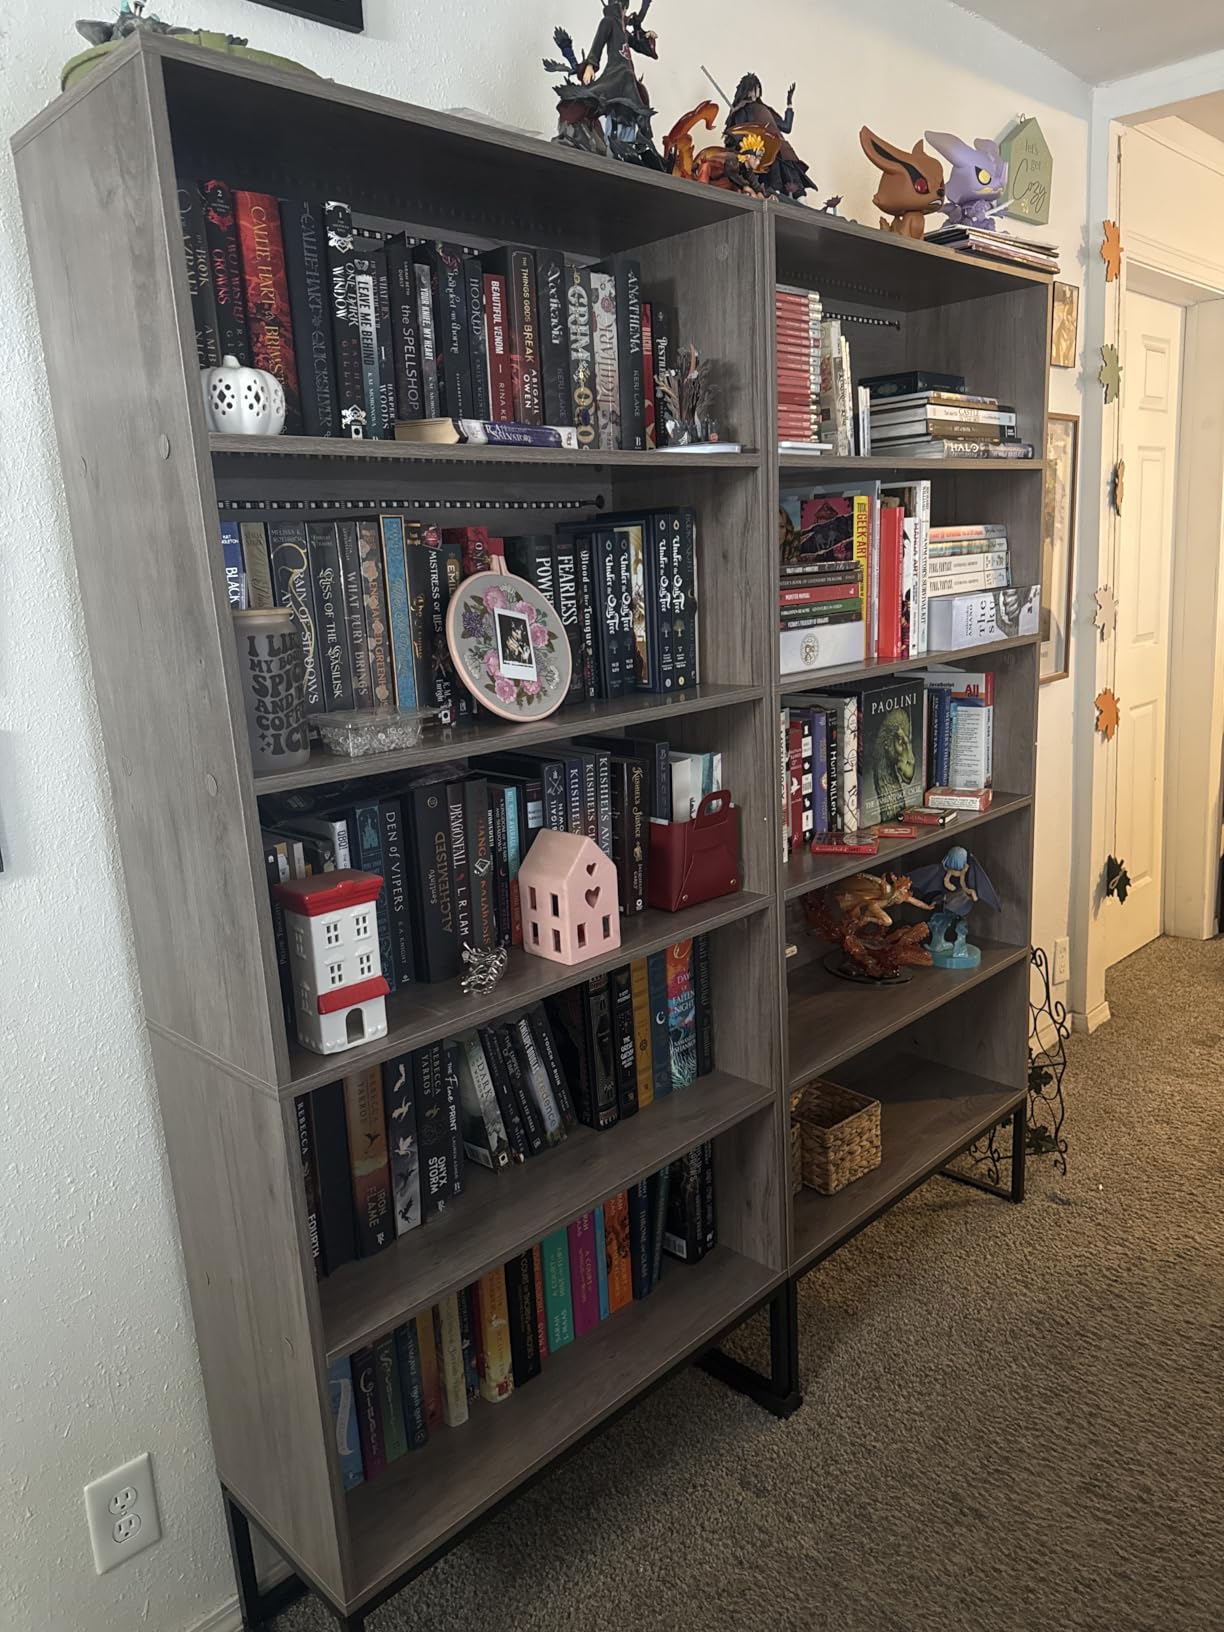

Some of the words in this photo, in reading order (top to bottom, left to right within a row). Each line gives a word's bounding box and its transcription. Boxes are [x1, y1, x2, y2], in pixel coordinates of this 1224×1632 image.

[1012, 158, 1047, 214] Cozy
[251, 206, 271, 261] CALLIE
[212, 249, 229, 304] CROWNS
[257, 267, 276, 304] HART
[345, 263, 356, 289] ONE
[521, 269, 531, 299] THINGS
[332, 266, 348, 320] WINDOW
[346, 292, 360, 327] DARK
[357, 280, 370, 309] LEAVE
[420, 288, 430, 305] YOUR
[470, 278, 481, 336] HOOKED
[491, 280, 502, 324] BEAUTIFUL
[359, 312, 373, 328] ME
[401, 305, 411, 325] the
[421, 305, 432, 327] KNIFE,
[523, 300, 532, 323] GODS
[568, 285, 591, 361] GRIM
[628, 270, 641, 354] ANATHEMA
[361, 330, 375, 366] BEHIND
[423, 328, 433, 340] MY
[424, 340, 434, 360] HEART
[493, 325, 504, 355] VENOM
[523, 324, 535, 363] BREAK
[264, 326, 284, 384] BRIMST
[403, 328, 419, 410] SPELLSHOP
[380, 384, 390, 430] WOODS
[499, 382, 507, 408] RINA
[523, 374, 532, 409] OWEN
[531, 369, 540, 415] ABIGAIL
[950, 441, 980, 453] HALO
[672, 535, 683, 568] Under
[856, 513, 867, 559] GEEK-ART
[580, 549, 591, 583] Blood
[605, 553, 616, 587] Under
[619, 552, 631, 585] Under
[658, 539, 669, 570] Under
[225, 567, 241, 604] BLACK
[347, 571, 360, 609] WHAT
[428, 549, 441, 600] MISTRESS
[447, 564, 458, 599] EMIL
[557, 555, 578, 626] FEARLESS
[323, 603, 336, 618] OF
[433, 601, 441, 611] OF
[658, 592, 672, 613] Tree
[672, 592, 686, 614] Tree
[977, 600, 987, 636] The
[326, 622, 338, 644] THE
[349, 614, 364, 645] FURY
[432, 613, 443, 633] LIES
[583, 606, 594, 647] Tongue
[606, 612, 620, 635] Tree
[620, 609, 633, 632] Tree
[246, 635, 260, 658] I
[265, 632, 302, 658] LIK
[249, 659, 274, 673] MY
[327, 644, 344, 699] BASILISK
[354, 650, 369, 697] BRINGS
[254, 692, 294, 715] AND
[871, 693, 917, 715] PAOLINI
[965, 684, 980, 697] All
[585, 763, 596, 822] KUSHIEL'S
[599, 756, 611, 822] KUSHIEL'S
[385, 811, 398, 842] DEN
[449, 803, 467, 869] DRAGONFALL
[388, 846, 400, 859] of
[391, 861, 404, 912] VIPERS
[435, 831, 453, 933] ALCHEMISED
[457, 886, 467, 897] L.
[458, 899, 468, 911] R.
[459, 912, 470, 936] LAM
[677, 972, 692, 985] DAY
[673, 1001, 696, 1014] NIGHT
[421, 1054, 431, 1096] YARROS
[431, 1046, 441, 1096] REBECCA
[478, 1061, 493, 1099] DARK
[445, 1074, 460, 1103] Fine
[297, 1101, 309, 1154] REBECCA
[448, 1104, 457, 1132] PRINT
[428, 1156, 439, 1195] STORM
[437, 1155, 449, 1187] ONYX
[367, 1185, 380, 1228] FLAME
[377, 1187, 386, 1216] IRON
[308, 1212, 320, 1258] FOURTH
